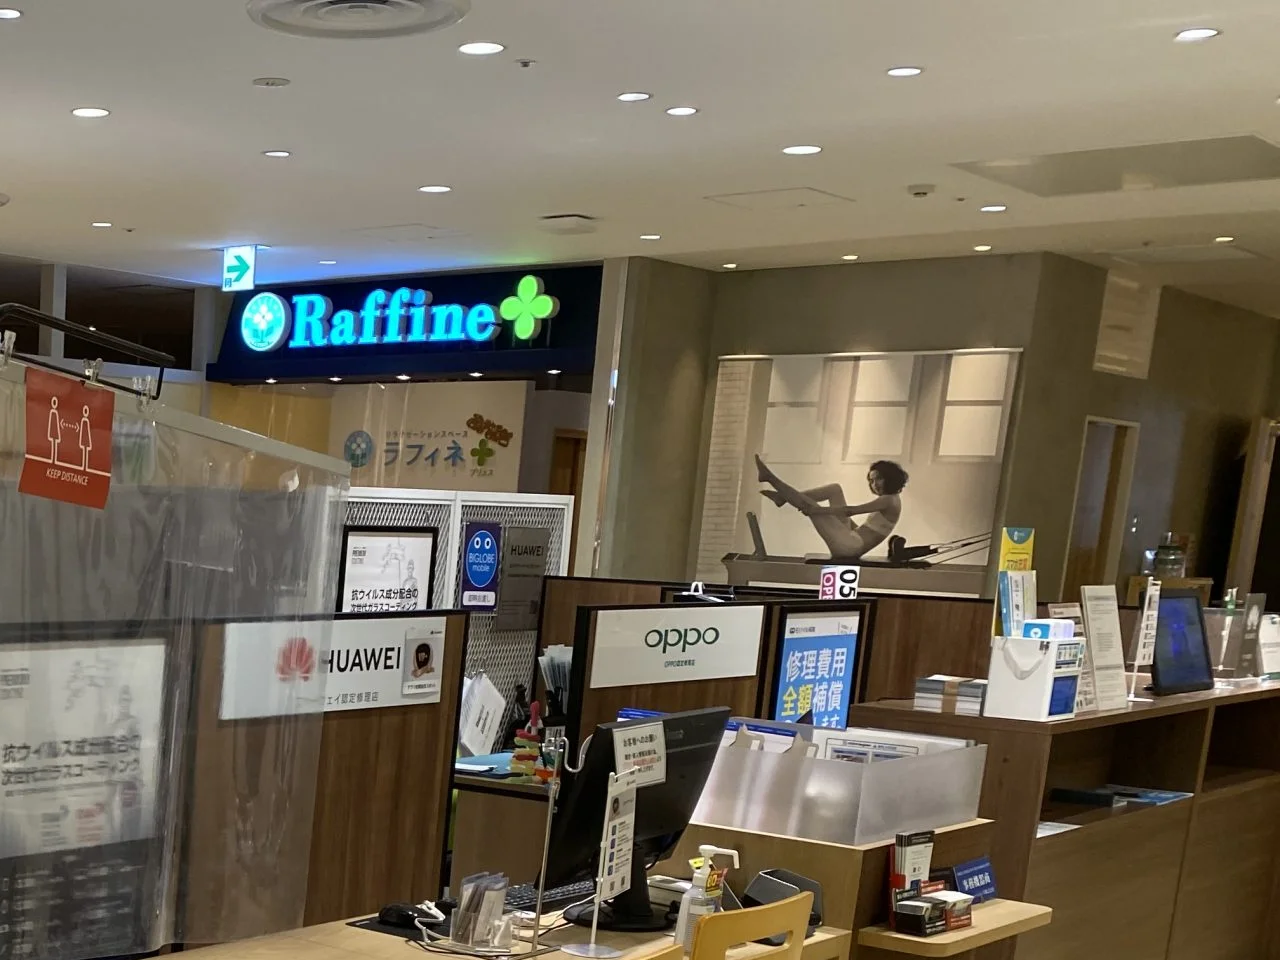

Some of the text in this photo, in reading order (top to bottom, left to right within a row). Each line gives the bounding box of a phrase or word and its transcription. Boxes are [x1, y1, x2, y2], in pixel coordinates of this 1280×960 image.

[289, 288, 496, 348] Raffine
[384, 440, 465, 467] ラフィネ
[46, 467, 88, 486] KEEP DISTANCE
[469, 553, 496, 563] BIGLOBE
[511, 545, 544, 556] HUAWEI
[472, 564, 490, 572] mobile
[351, 588, 418, 601] 抗ウイルス成分配合の
[644, 627, 720, 654] oppo
[786, 648, 847, 682] 修理費用
[781, 681, 843, 717] 全額補償
